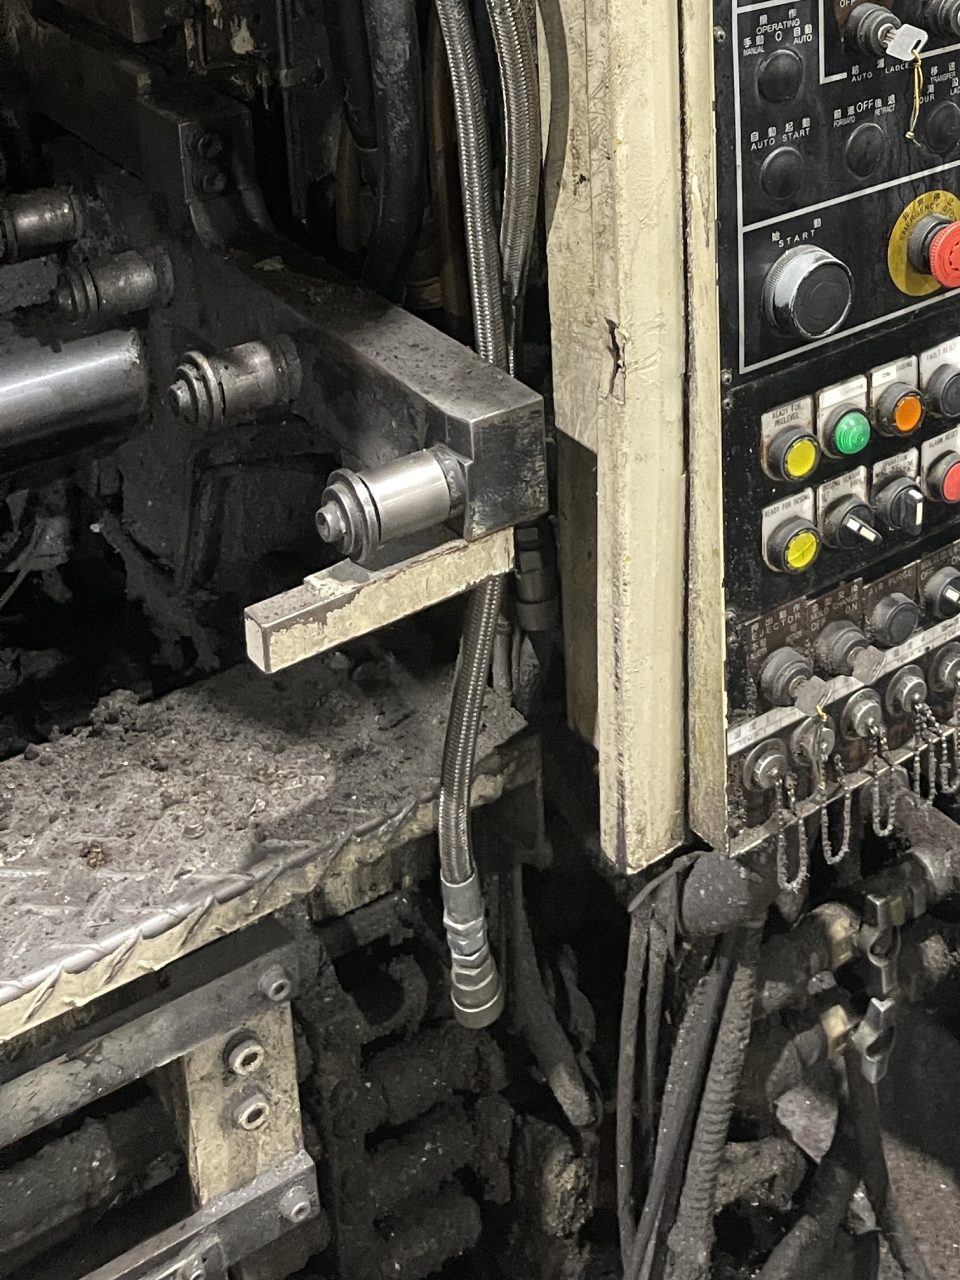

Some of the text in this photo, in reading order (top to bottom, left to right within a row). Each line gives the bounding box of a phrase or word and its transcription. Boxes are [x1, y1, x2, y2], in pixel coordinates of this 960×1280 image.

[756, 18, 801, 35] OPERATING
[793, 33, 813, 45] AUTO
[851, 71, 873, 82] AUTO
[856, 98, 874, 113] OFF
[750, 127, 811, 151] AUTO START
[778, 229, 816, 248] START
